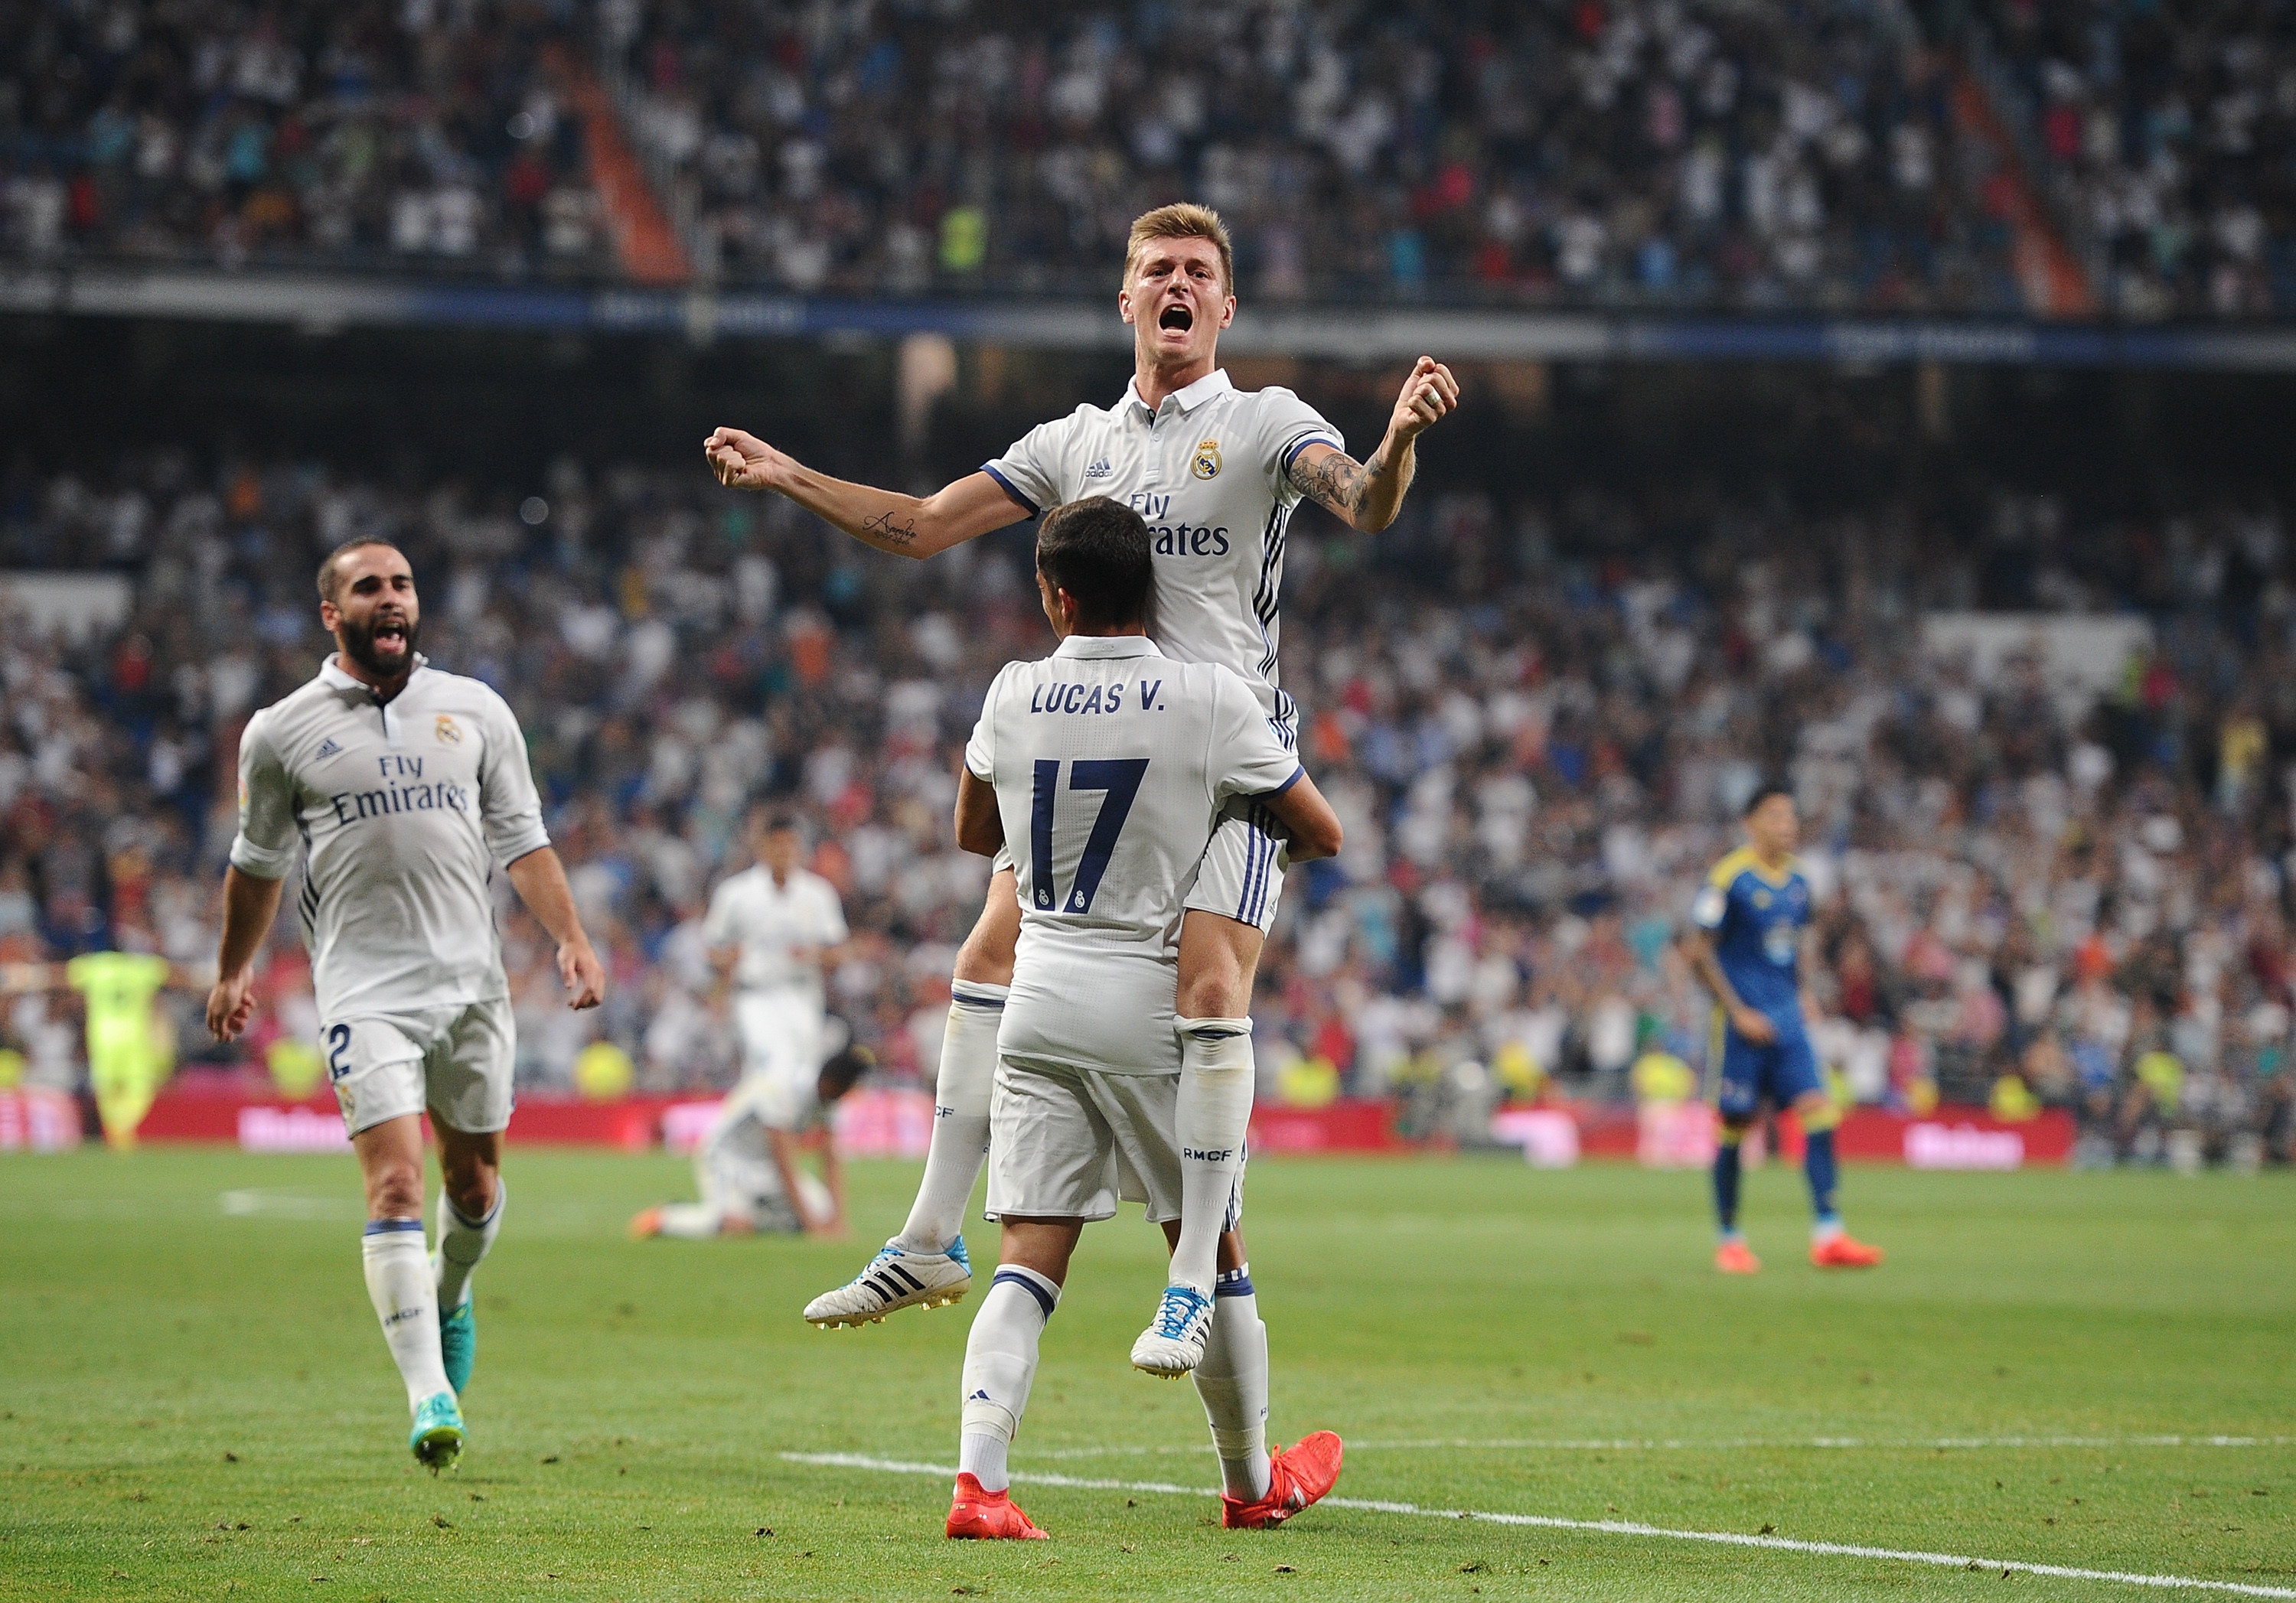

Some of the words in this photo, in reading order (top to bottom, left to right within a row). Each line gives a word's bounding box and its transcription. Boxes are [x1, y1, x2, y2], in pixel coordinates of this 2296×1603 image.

[1085, 469, 1113, 477] adidas
[1129, 492, 1170, 520] Fly
[1030, 683, 1124, 715] LUCAS
[1140, 679, 1165, 711] V.
[378, 754, 422, 777] Fly
[331, 780, 468, 826] Emirates
[1031, 758, 1150, 914] 17
[329, 1023, 351, 1080] 2
[1183, 1148, 1232, 1162] RMCF
